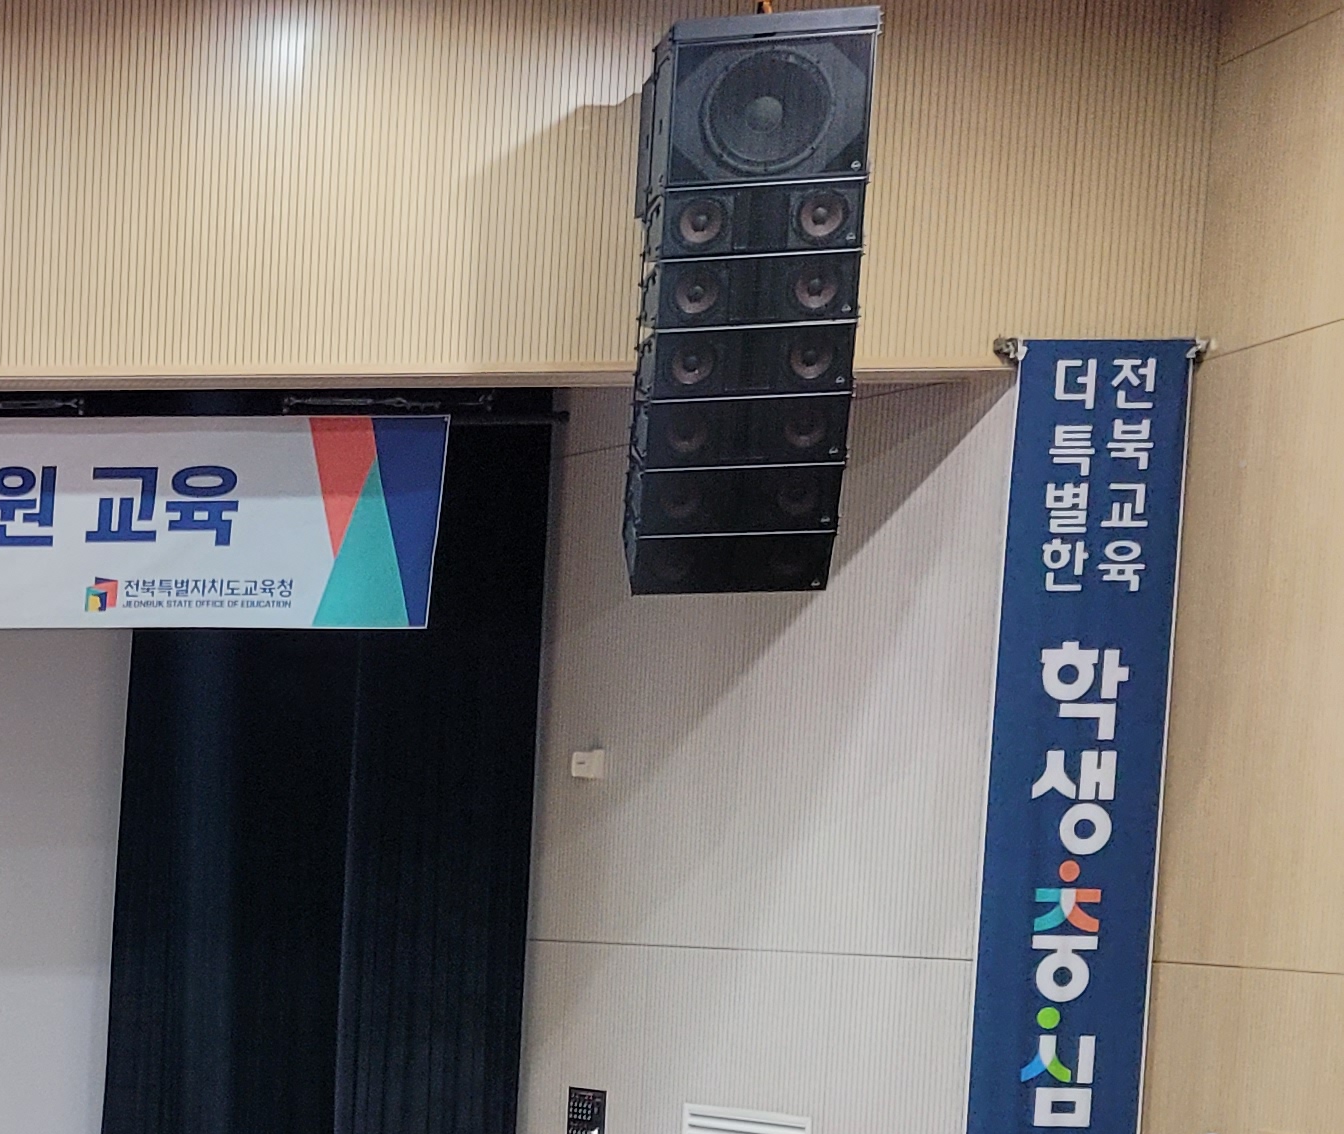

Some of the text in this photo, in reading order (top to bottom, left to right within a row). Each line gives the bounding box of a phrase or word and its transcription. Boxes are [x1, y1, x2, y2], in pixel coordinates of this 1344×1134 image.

[85, 465, 239, 547] 교육
[1042, 358, 1098, 592] 더 특별한
[1098, 358, 1157, 592] 전북교육
[122, 600, 292, 609] JEONBUK STATE OFFICE OF EDUCATION
[123, 578, 294, 598] 전북특별자치도교육청
